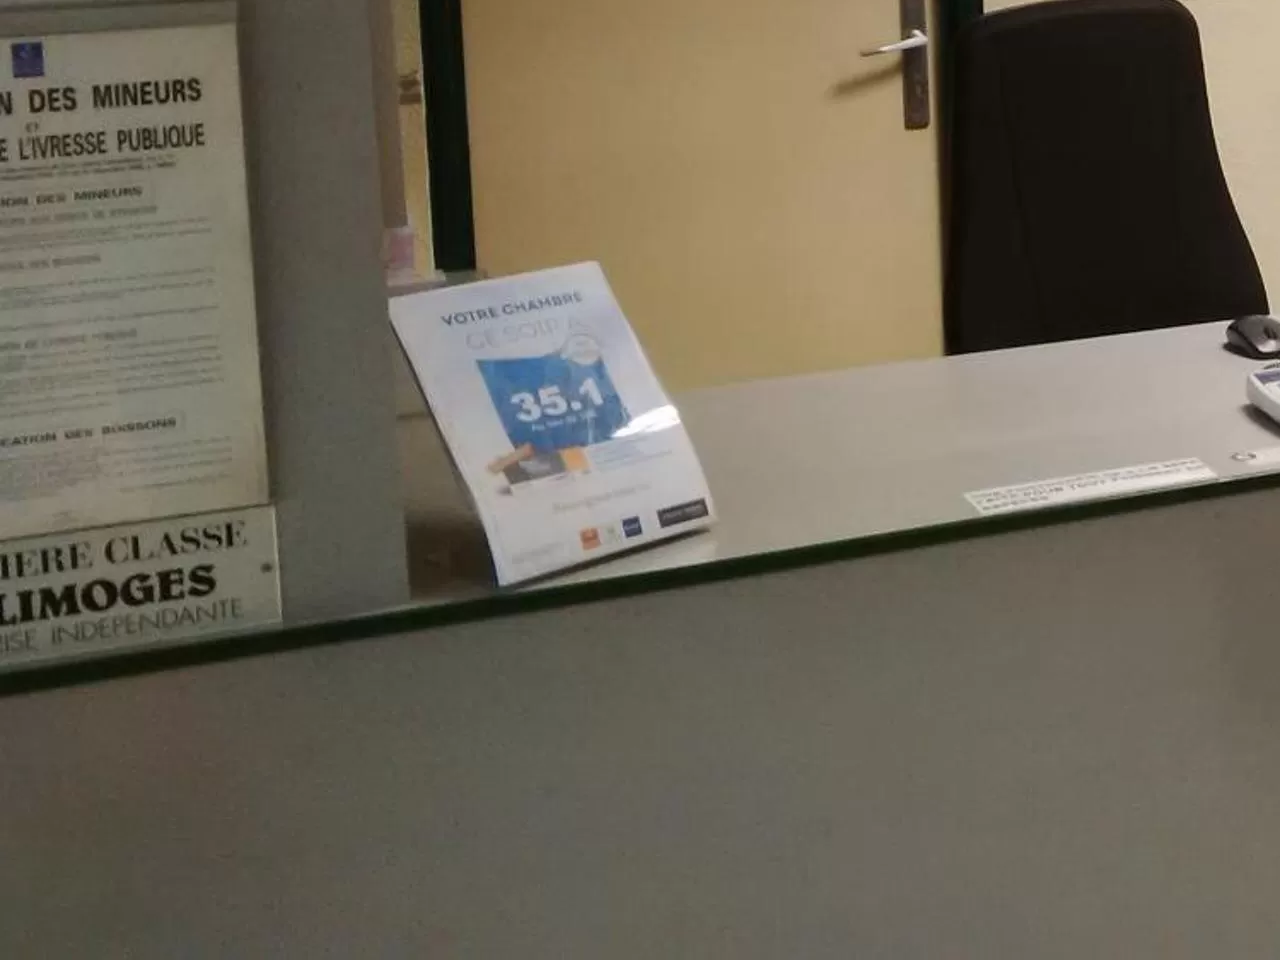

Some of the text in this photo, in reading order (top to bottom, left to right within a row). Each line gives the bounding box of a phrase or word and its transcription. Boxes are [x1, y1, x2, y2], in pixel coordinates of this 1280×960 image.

[28, 86, 77, 113] DES
[92, 77, 202, 109] MINEURS
[18, 131, 107, 160] L'IVRESSE
[117, 123, 205, 153] PUBLIQUE
[440, 290, 583, 327] VOTRE CHAMBRE
[104, 520, 247, 564] CLASSE
[0, 564, 217, 627] LIMOGES
[51, 597, 244, 645] INDEPENDANTE
